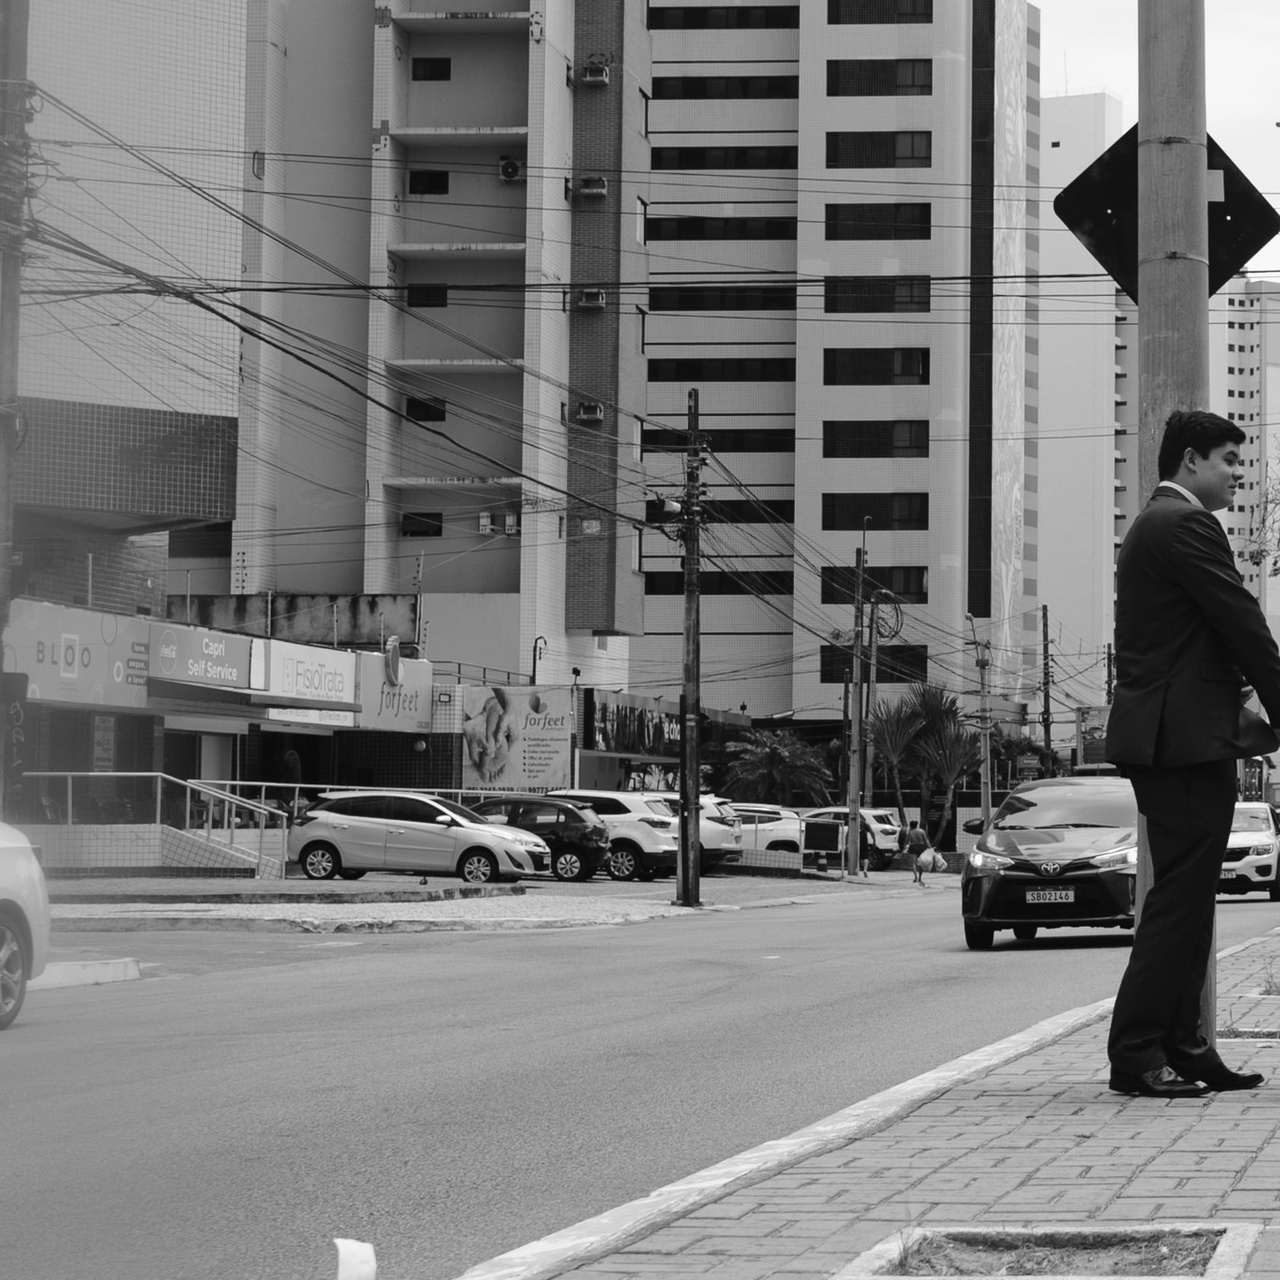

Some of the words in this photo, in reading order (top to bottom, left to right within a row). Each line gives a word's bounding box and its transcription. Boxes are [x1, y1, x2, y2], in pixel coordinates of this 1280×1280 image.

[36, 640, 91, 669] BLOO
[202, 638, 226, 658] Capri
[187, 658, 205, 677] Self
[206, 660, 238, 681] Service
[295, 660, 344, 693] FisioTrata
[378, 681, 418, 718] forfeet
[522, 712, 565, 730] forfeet
